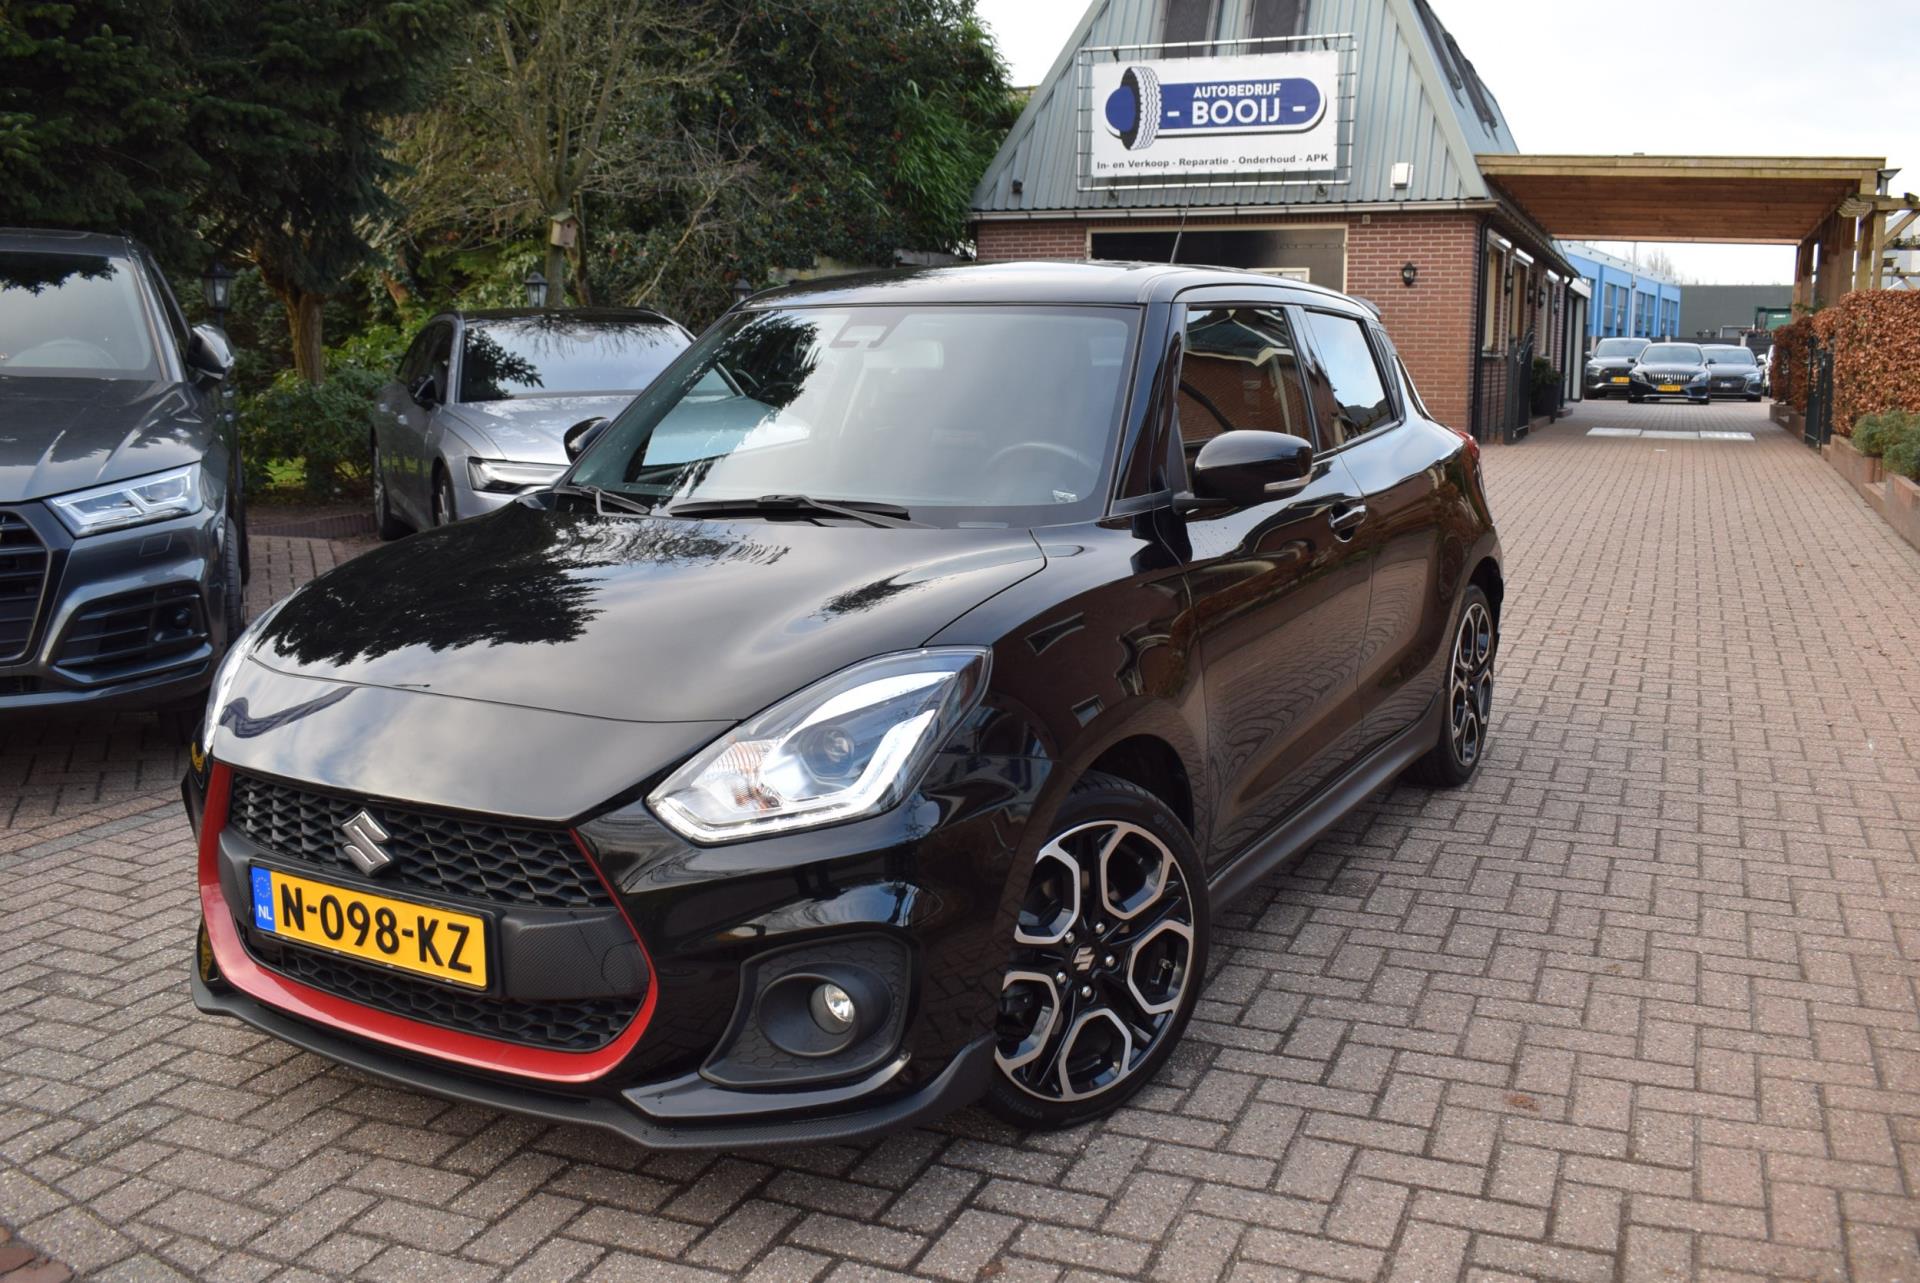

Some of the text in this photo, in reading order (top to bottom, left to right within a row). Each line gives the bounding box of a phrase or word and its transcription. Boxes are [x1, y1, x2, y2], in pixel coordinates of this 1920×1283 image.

[1193, 82, 1282, 98] AUTOBEDRIJF
[1192, 98, 1280, 125] BOOIJ
[1097, 161, 1110, 170] In-
[1112, 161, 1125, 169] en
[1128, 159, 1170, 170] Verkoop
[1179, 157, 1229, 168] Reparatie
[1238, 154, 1296, 165] Onderhoud
[1306, 153, 1329, 163] APK
[258, 903, 273, 921] NL
[281, 883, 472, 974] N-098-KZ
